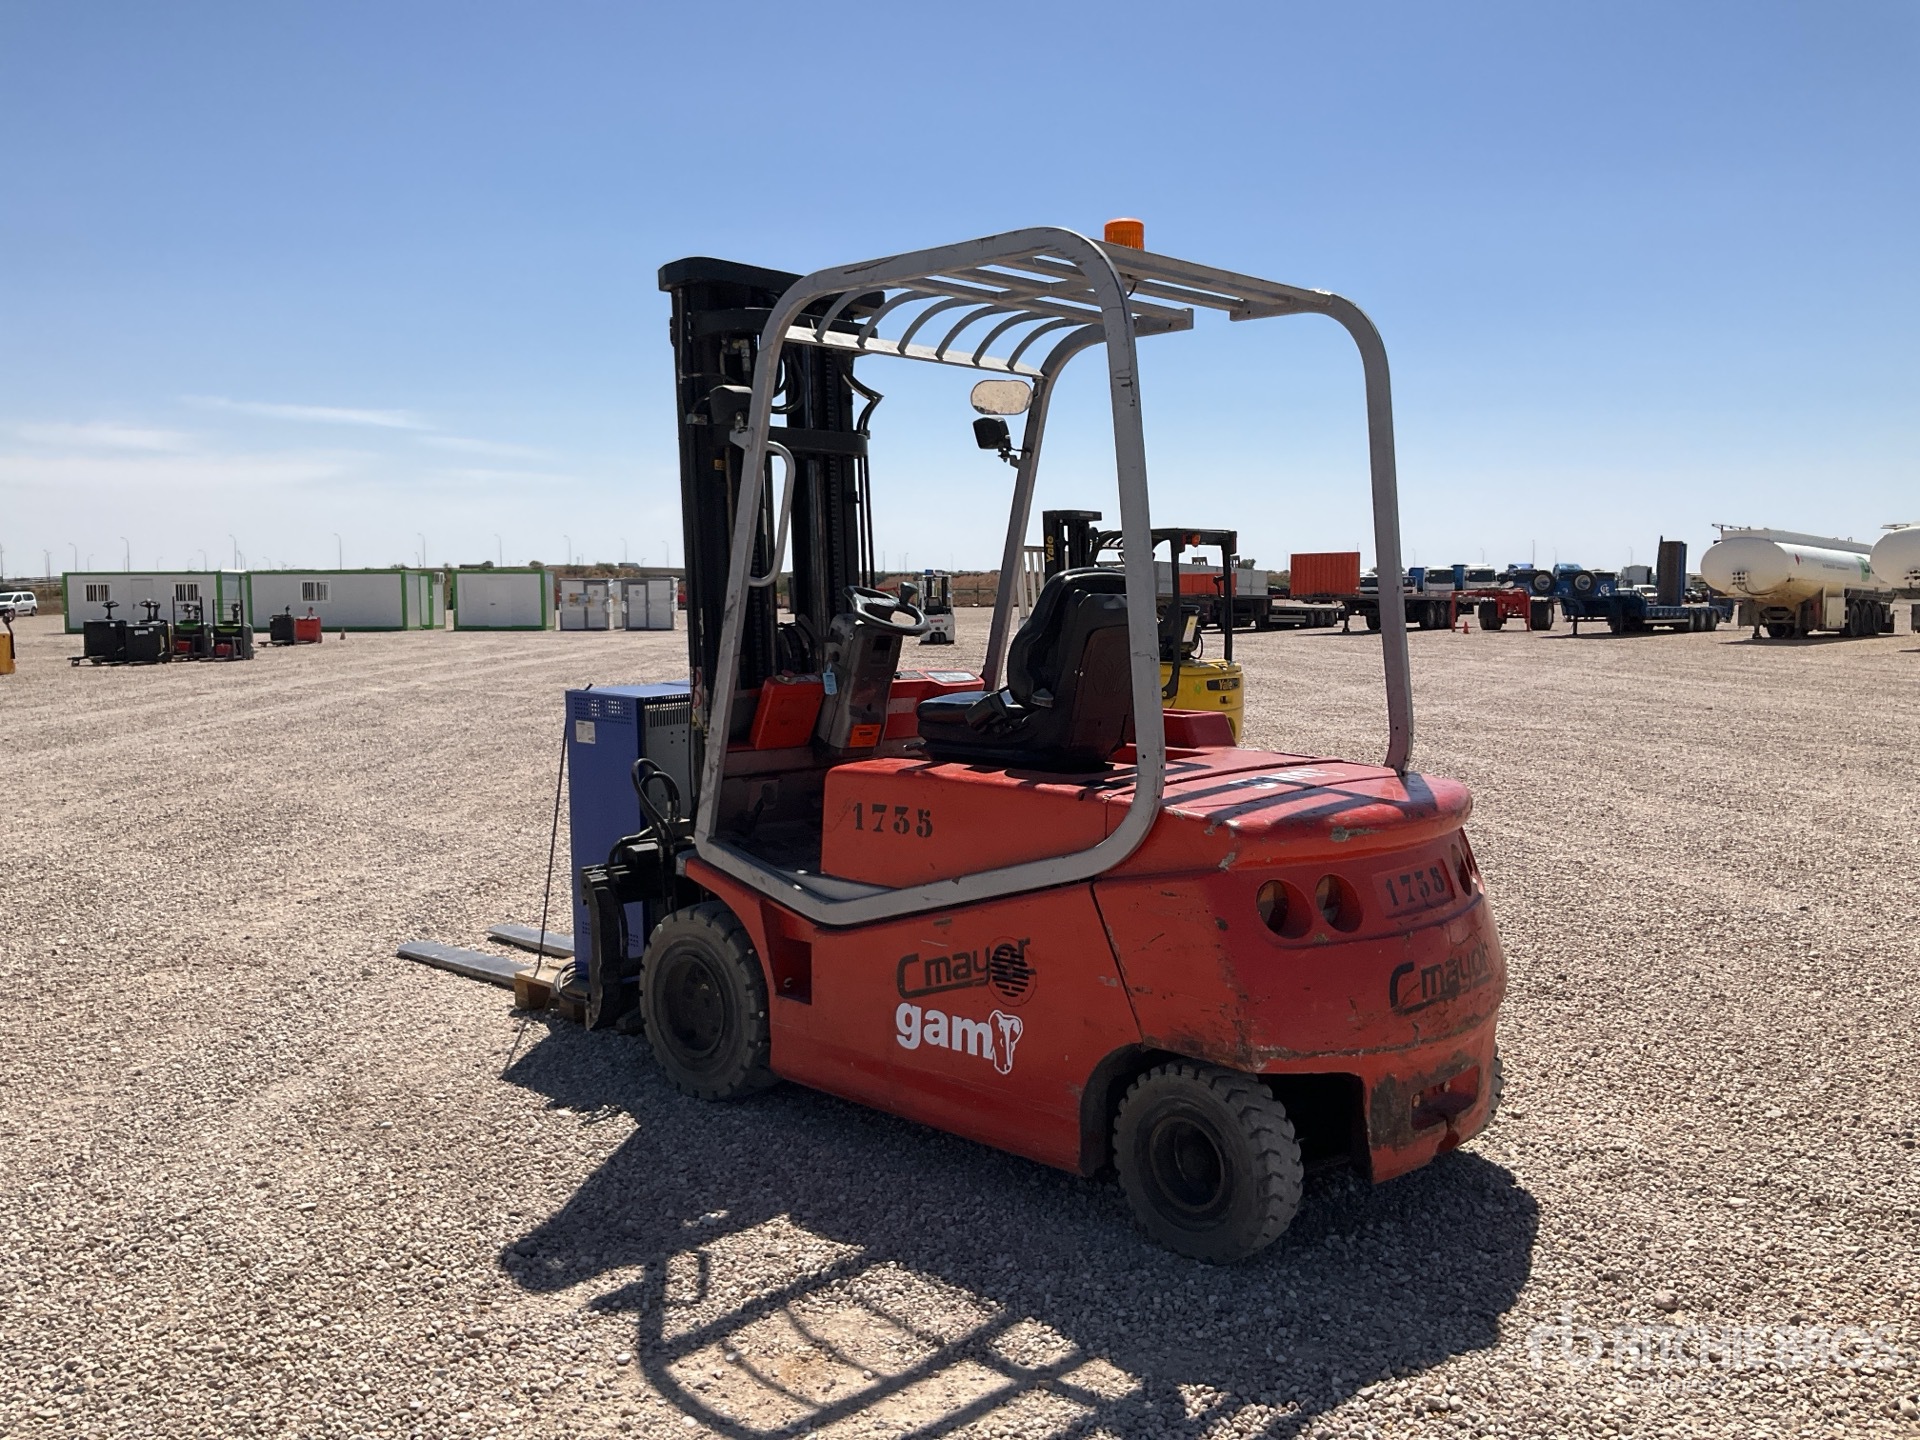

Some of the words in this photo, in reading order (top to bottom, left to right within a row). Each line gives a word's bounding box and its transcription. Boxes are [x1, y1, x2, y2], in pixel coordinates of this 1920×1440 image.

[1045, 535, 1054, 562] Yale
[853, 802, 933, 837] 1735
[896, 1002, 994, 1060] gam
